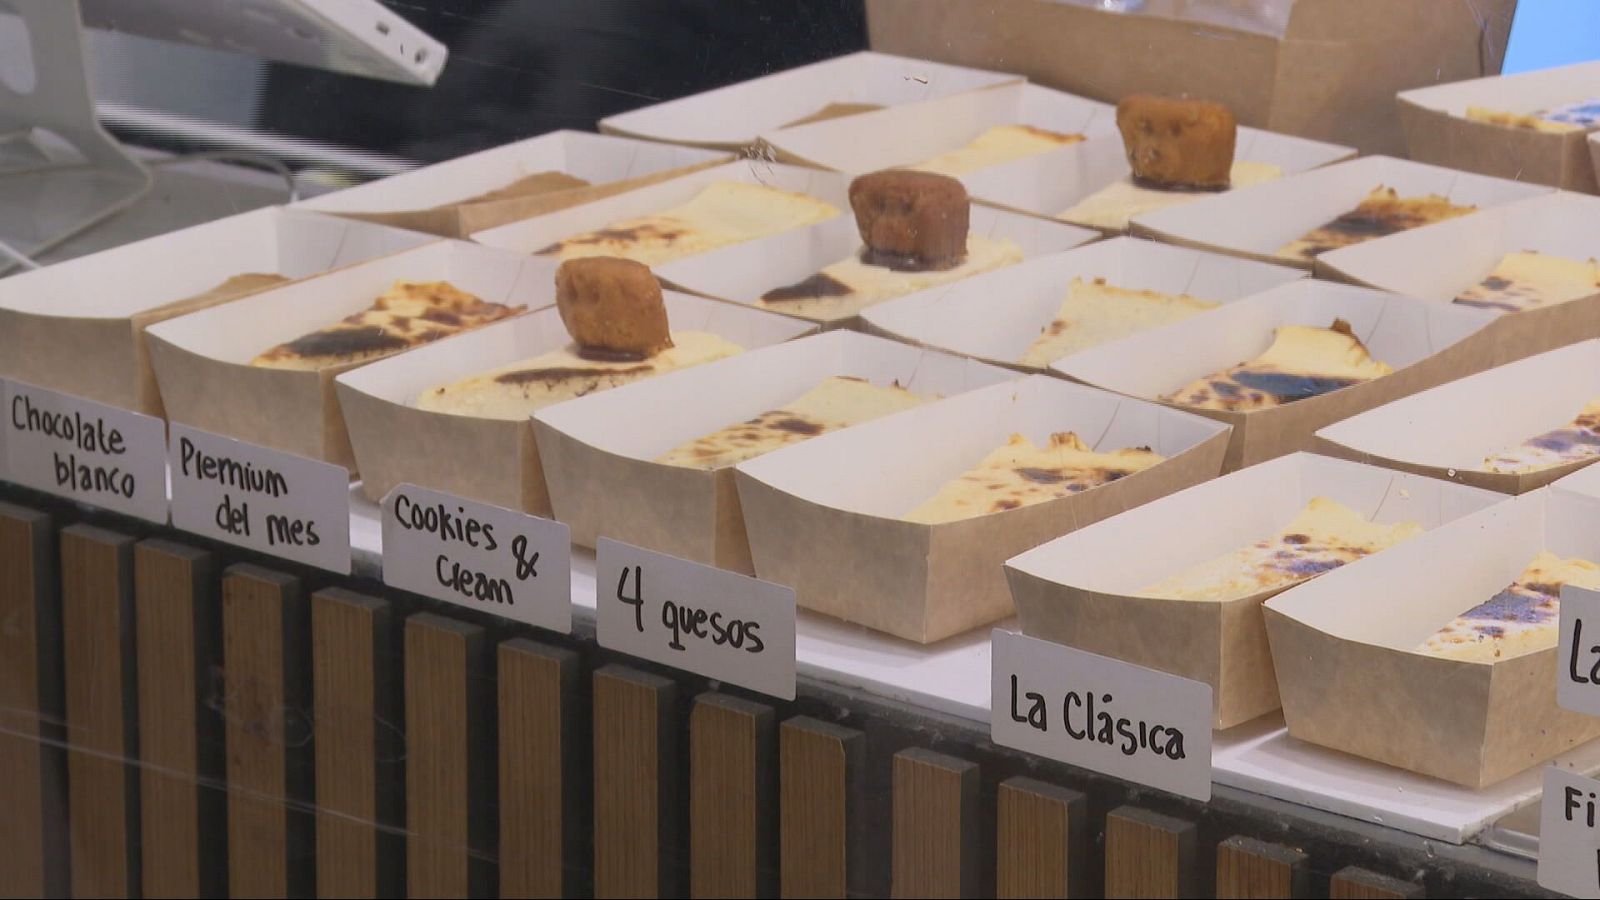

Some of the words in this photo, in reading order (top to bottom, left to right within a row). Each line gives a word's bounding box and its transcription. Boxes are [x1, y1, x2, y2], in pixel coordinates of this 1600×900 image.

[12, 395, 126, 454] Chocolate
[54, 452, 135, 498] blanco
[215, 495, 250, 536] del
[266, 514, 320, 546] mes
[394, 494, 498, 551] Cookies
[512, 535, 540, 580] &
[617, 566, 644, 632] 4
[662, 601, 764, 653] quesos
[1011, 674, 1047, 732] La
[1063, 691, 1186, 760] Clásica
